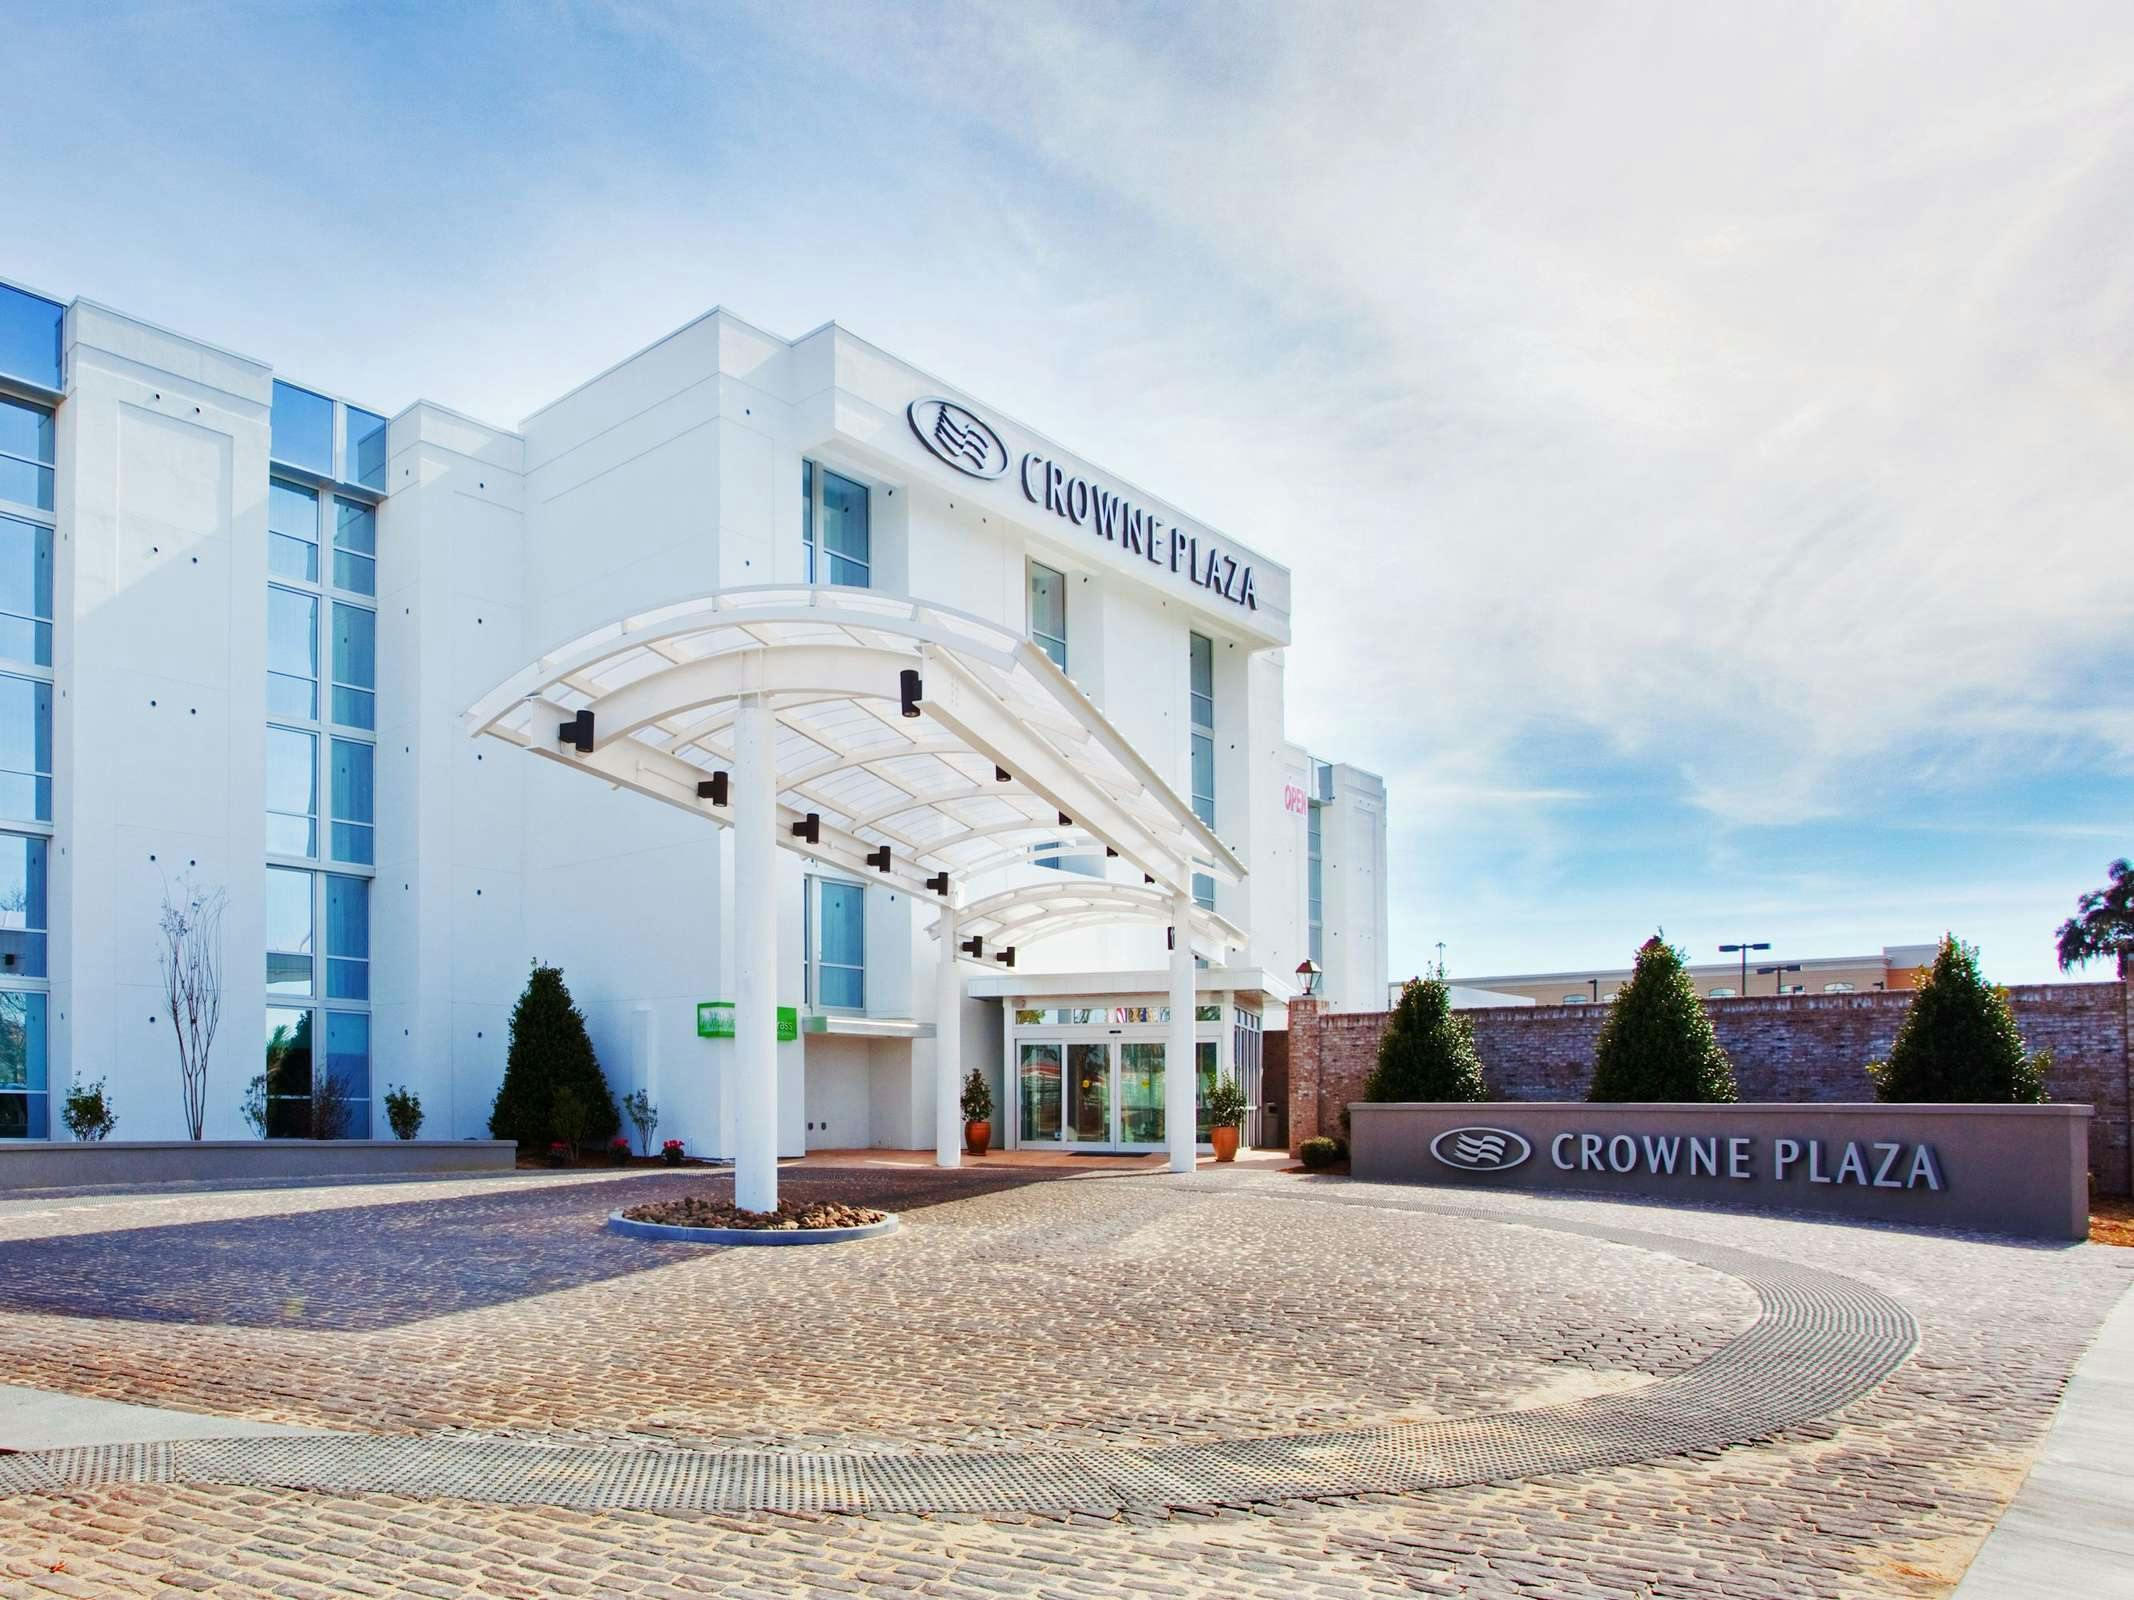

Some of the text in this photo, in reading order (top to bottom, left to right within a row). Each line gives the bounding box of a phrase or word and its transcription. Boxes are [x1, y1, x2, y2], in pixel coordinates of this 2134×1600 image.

[1021, 451, 1259, 611] CROWNE PLAZA
[1551, 1133, 1944, 1191] CROWNE PLAZA
